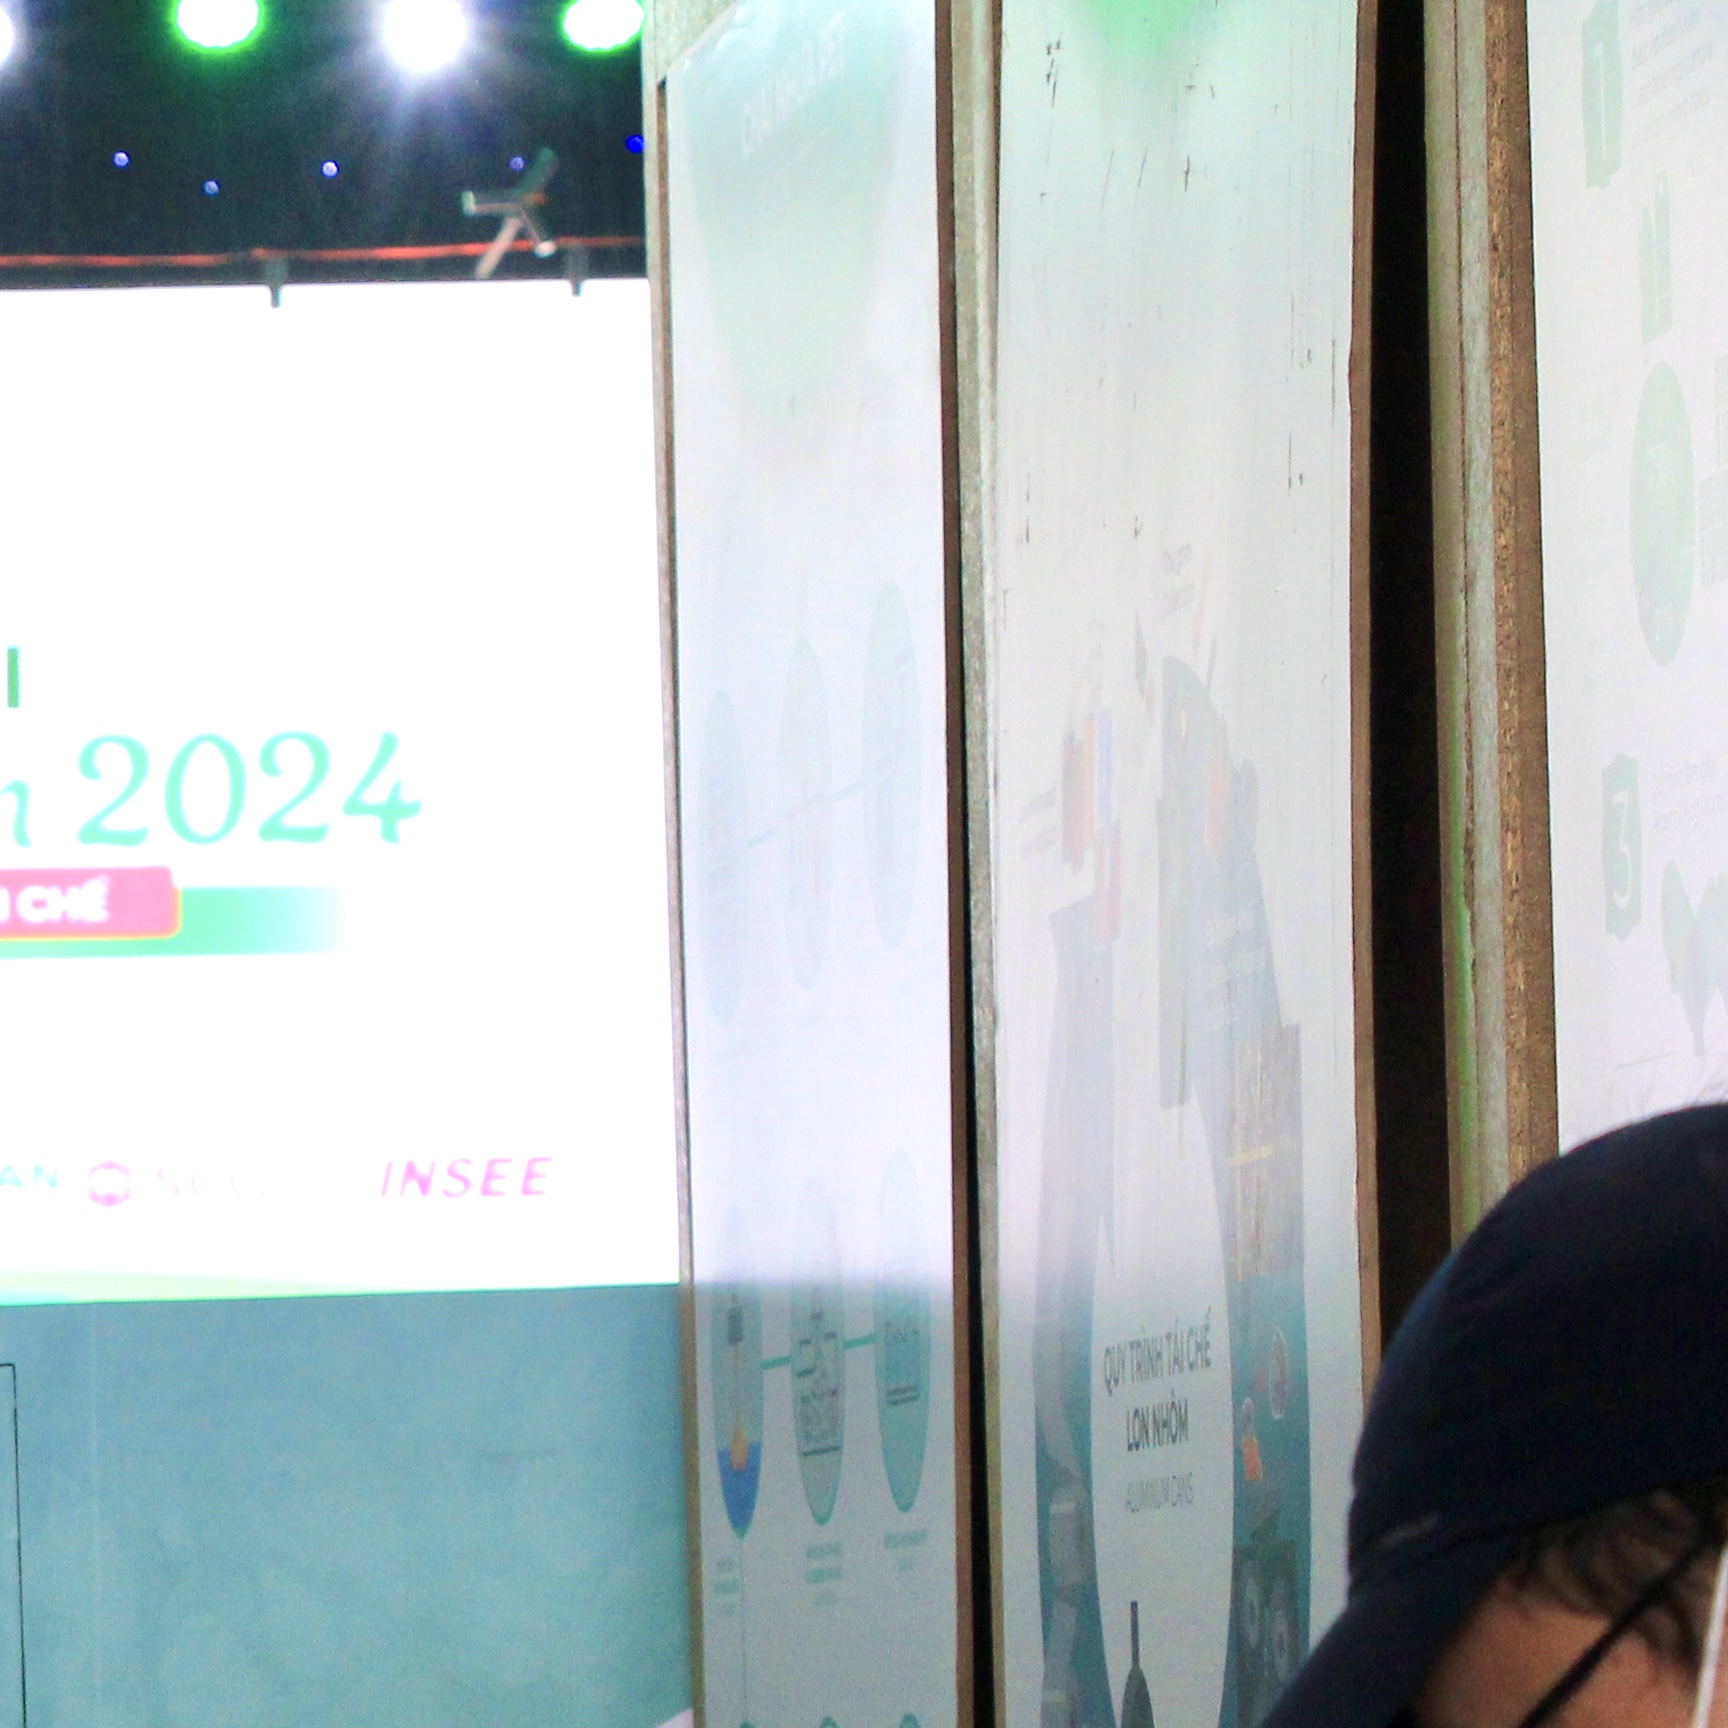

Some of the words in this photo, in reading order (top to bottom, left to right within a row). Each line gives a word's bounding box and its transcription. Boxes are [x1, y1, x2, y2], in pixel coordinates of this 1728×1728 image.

[76, 731, 424, 848] 2024
[17, 874, 111, 924] CHẾ
[379, 1155, 555, 1200] INSEE
[1126, 1404, 1150, 1452] LON
